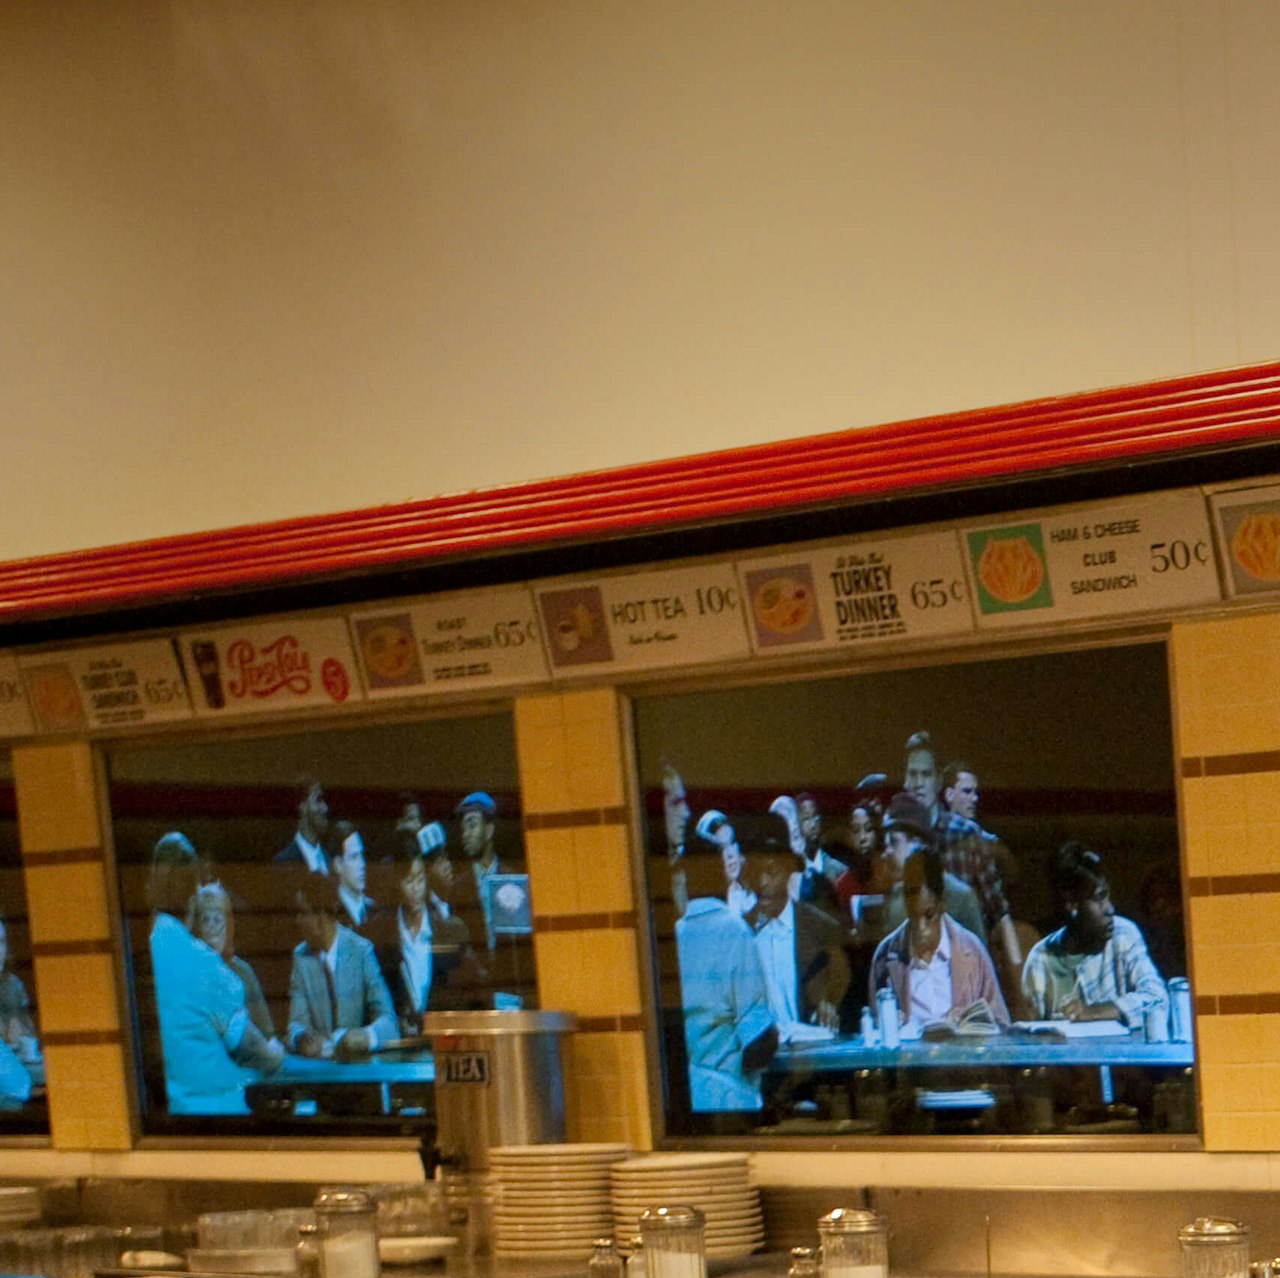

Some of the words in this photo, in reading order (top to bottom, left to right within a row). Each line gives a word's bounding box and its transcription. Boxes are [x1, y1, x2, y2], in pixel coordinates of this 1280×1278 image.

[1050, 527, 1079, 543] HAM
[1082, 526, 1091, 540] &
[1094, 519, 1140, 538] CHEESE
[1083, 550, 1117, 567] CLUB
[1151, 538, 1209, 573] 50¢
[830, 563, 892, 597] TURKEY
[1070, 574, 1138, 595] SANDWICH
[911, 579, 963, 610] 65¢
[610, 600, 646, 624] HOT
[650, 596, 688, 620] TEA
[835, 593, 901, 626] DINNER
[447, 1055, 484, 1083] TEA
